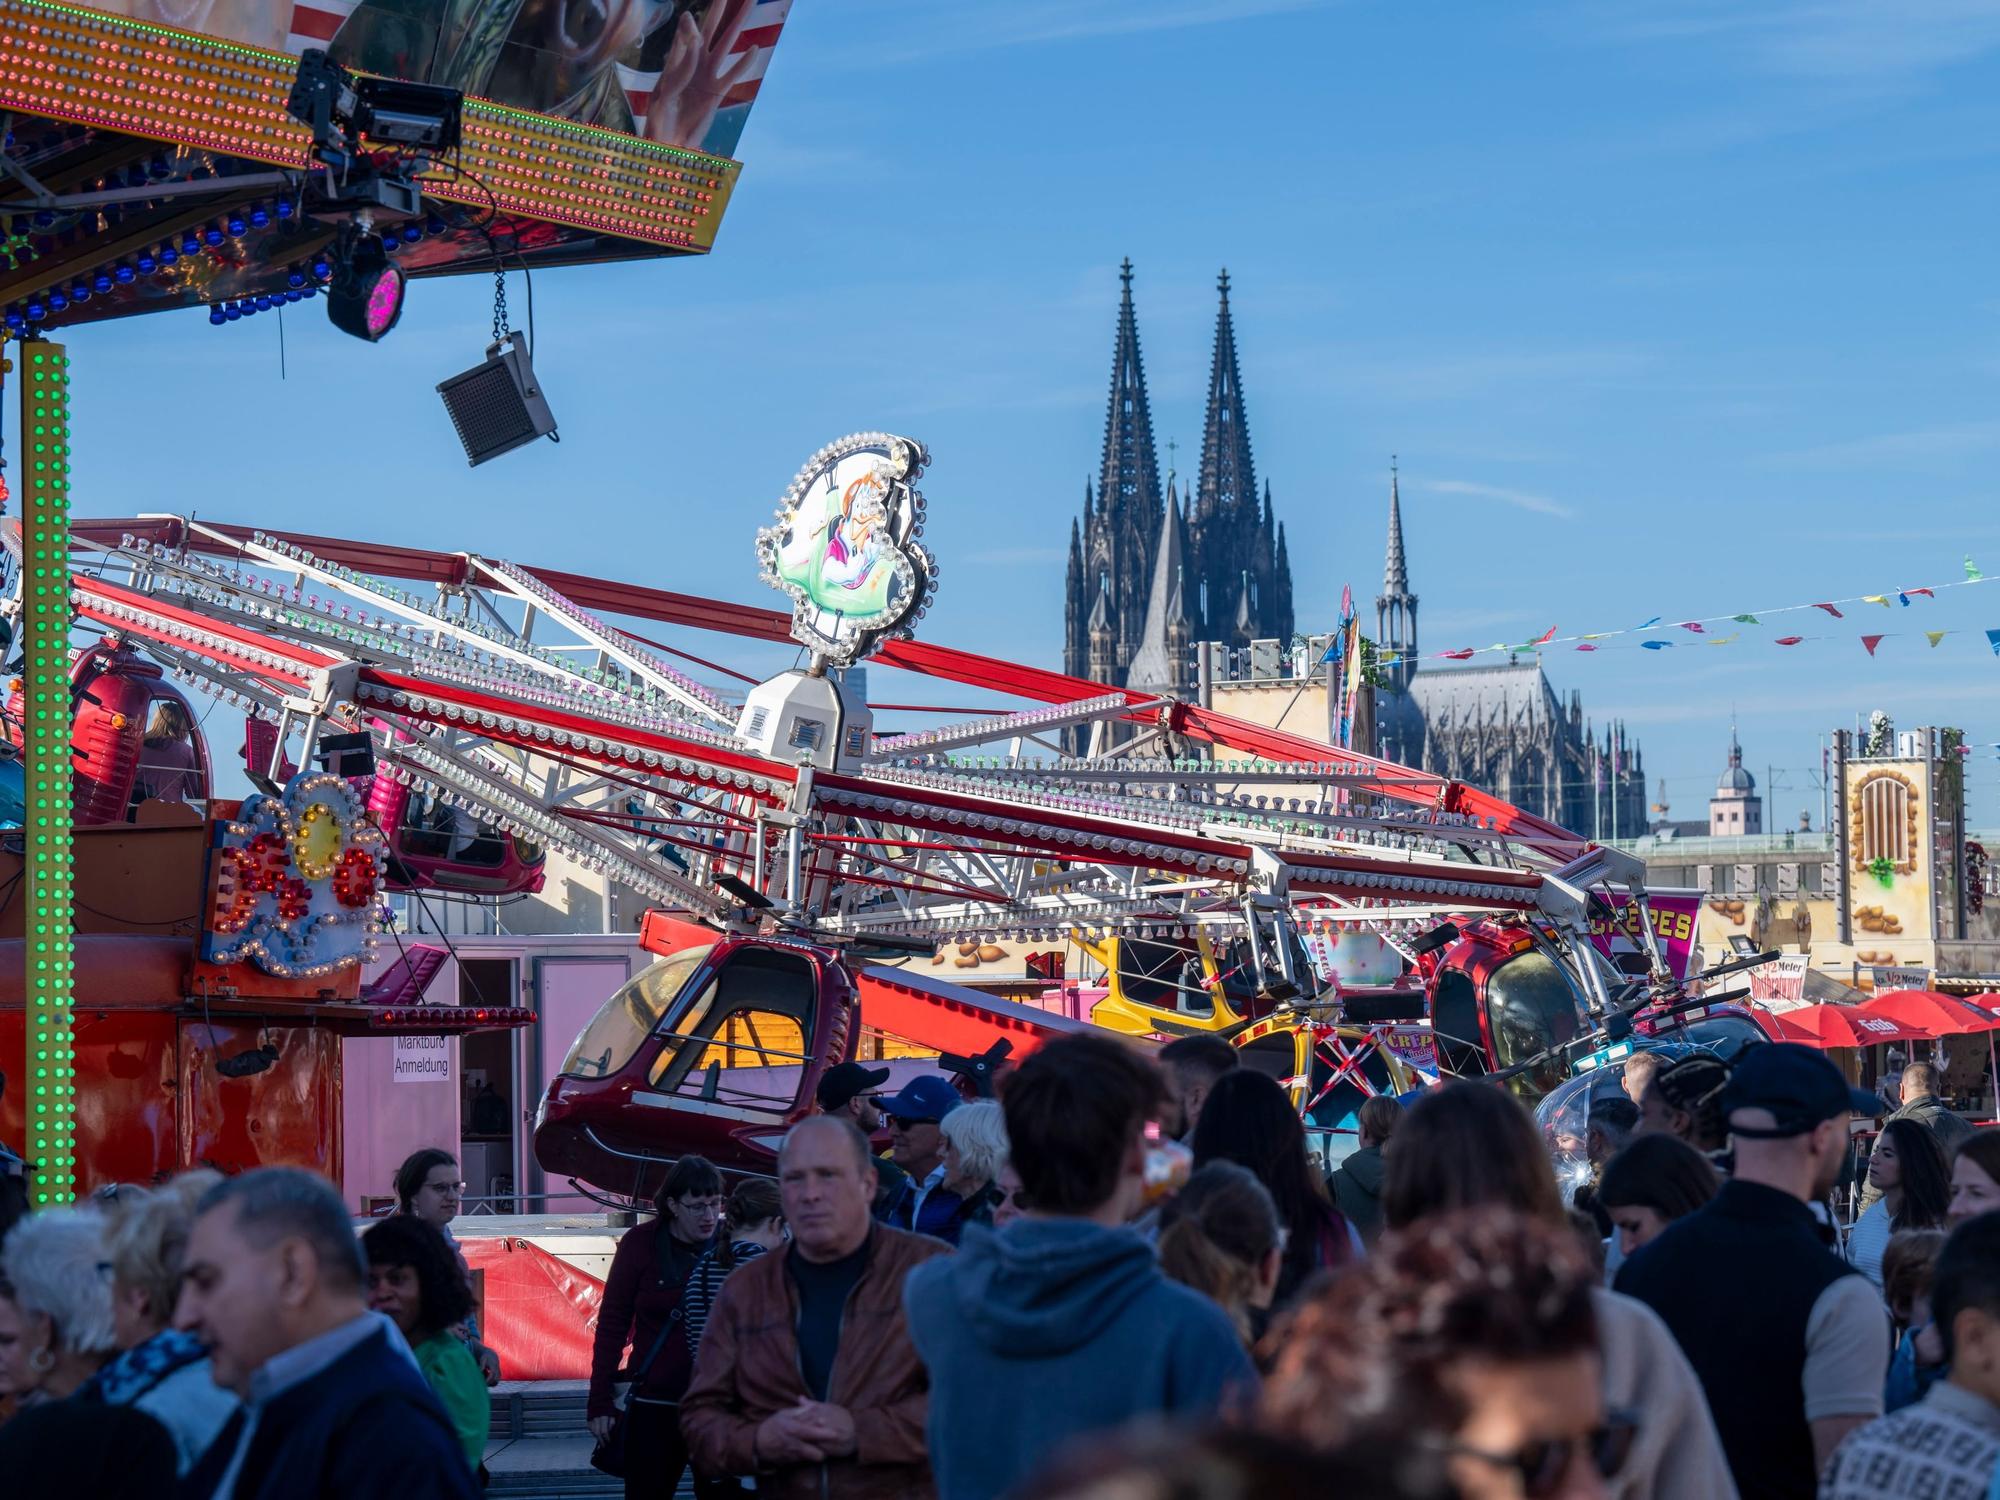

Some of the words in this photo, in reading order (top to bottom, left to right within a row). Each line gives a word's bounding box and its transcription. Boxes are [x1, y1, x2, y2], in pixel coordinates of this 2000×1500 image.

[1591, 907, 1692, 940] CEPES
[1778, 961, 1803, 973] Meter
[1902, 974, 1925, 985] Meter
[395, 1057, 448, 1076] Anmeldung
